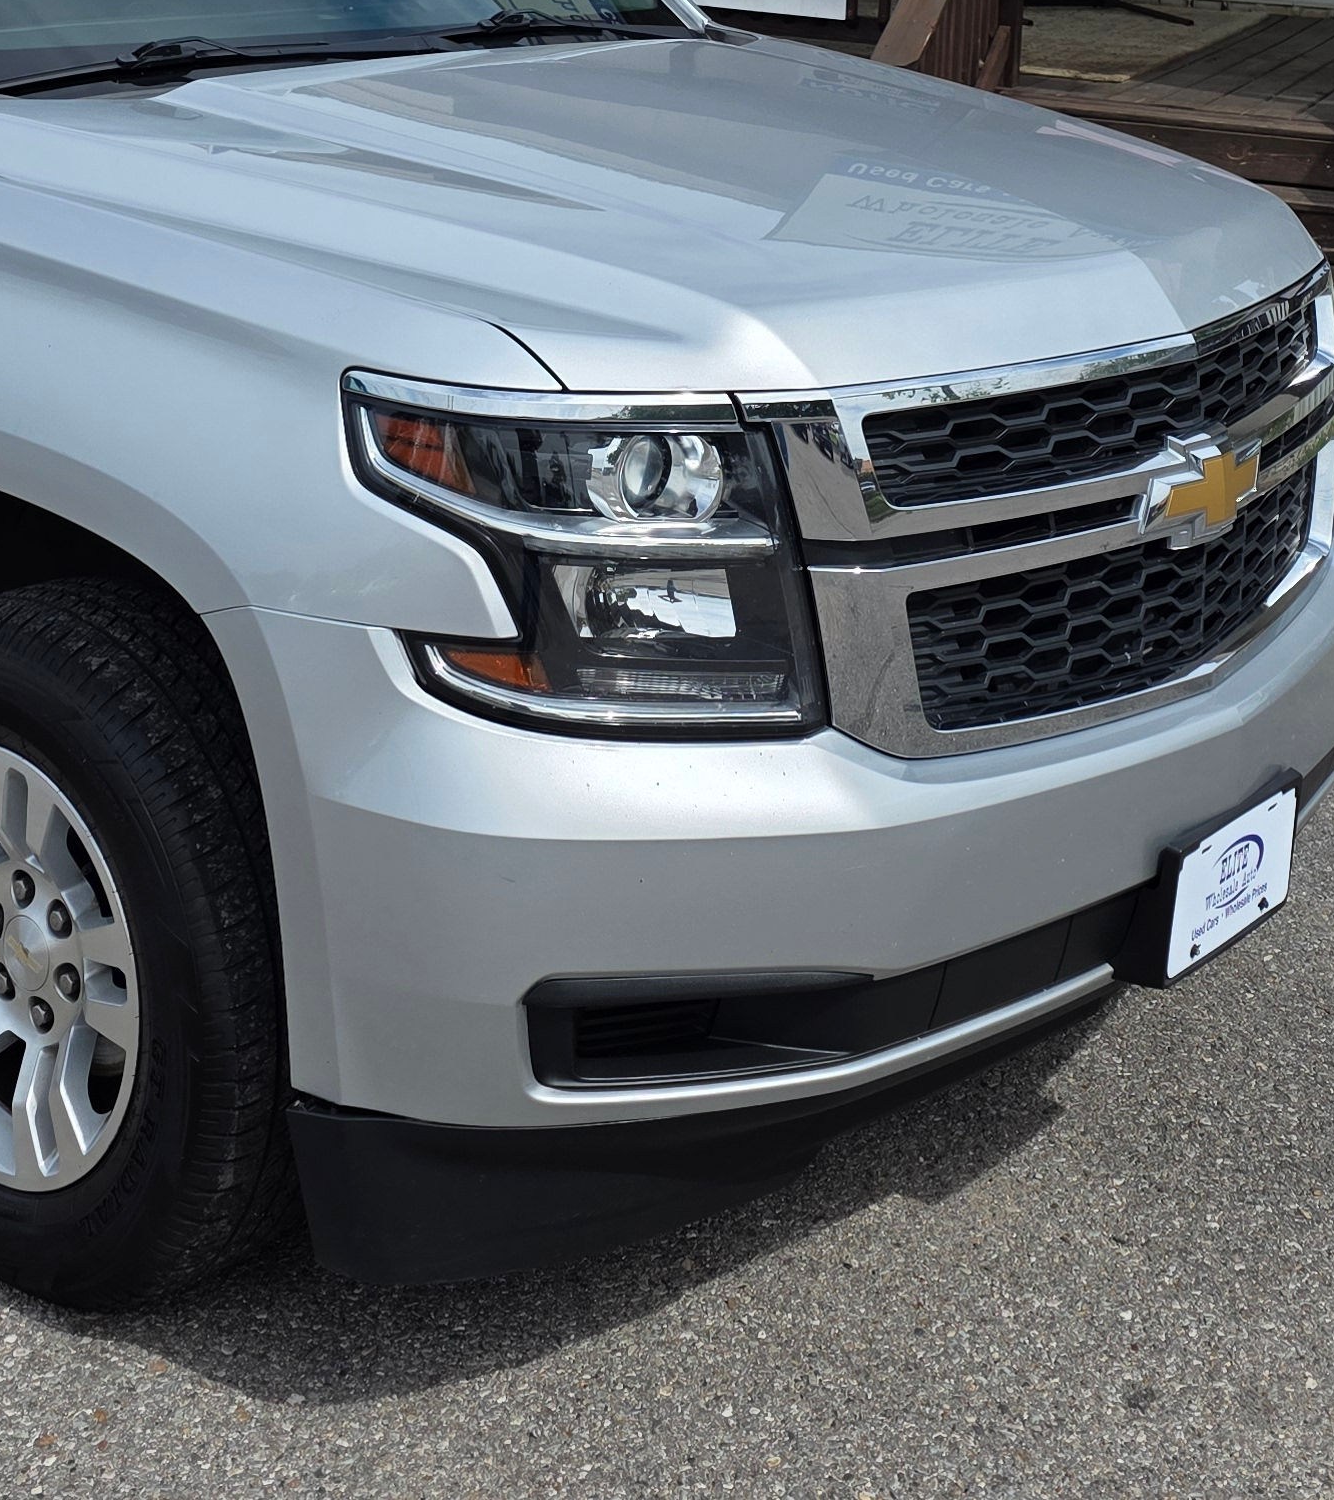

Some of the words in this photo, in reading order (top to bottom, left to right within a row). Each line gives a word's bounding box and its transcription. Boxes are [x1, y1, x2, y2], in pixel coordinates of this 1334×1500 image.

[1219, 843, 1250, 885] ELITE
[1205, 878, 1238, 911] Wholesale
[1242, 868, 1257, 887] Auto
[1191, 921, 1206, 941] Used
[1207, 916, 1219, 931] Cars
[1225, 893, 1251, 919] Wholesale
[1252, 883, 1268, 901] Prices
